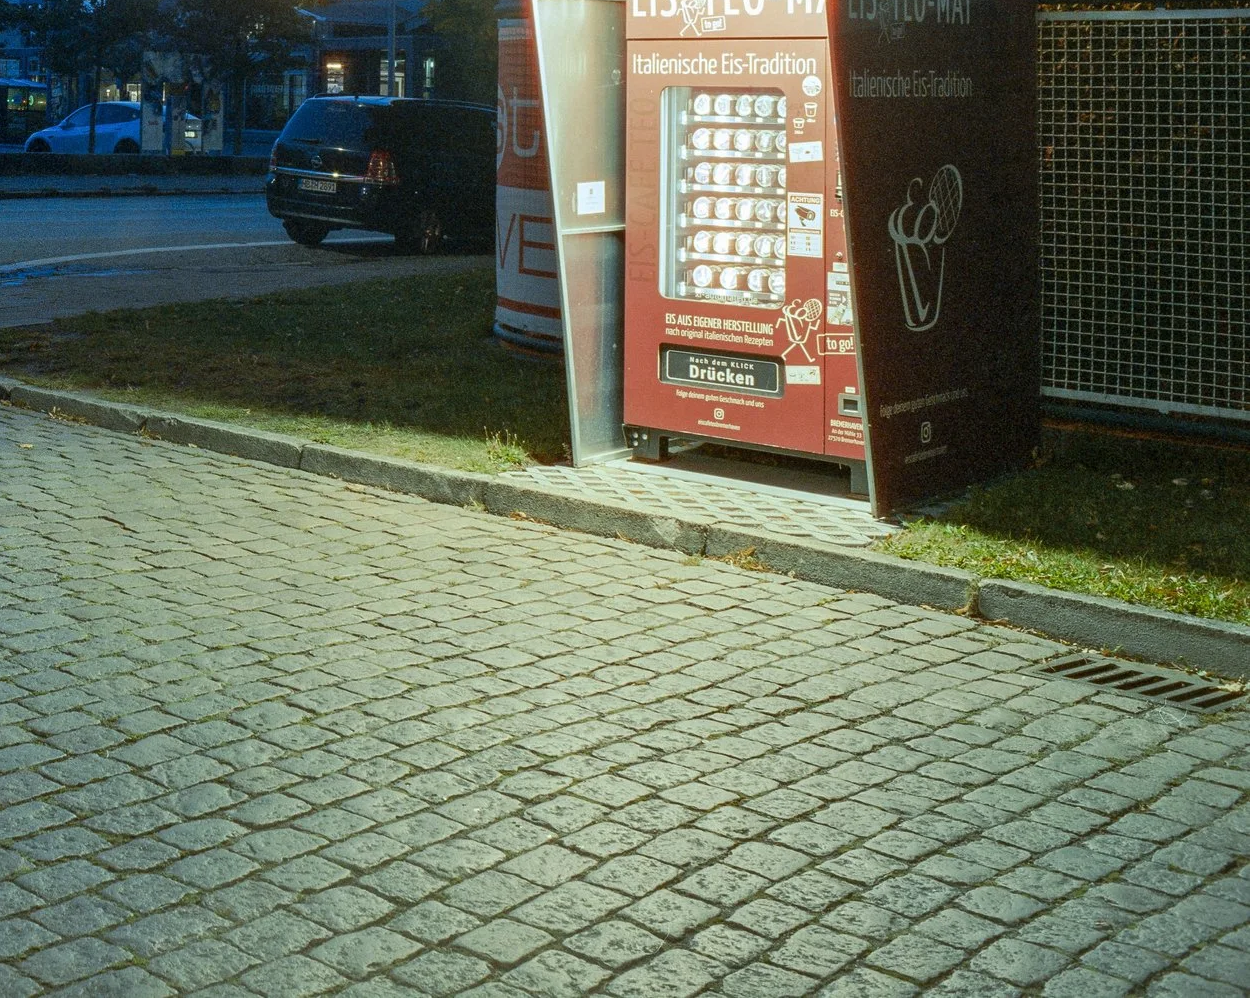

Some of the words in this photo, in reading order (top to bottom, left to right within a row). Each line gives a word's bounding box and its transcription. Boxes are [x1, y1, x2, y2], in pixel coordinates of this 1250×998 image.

[633, 53, 717, 75] Italienische
[721, 52, 817, 75] Eis-Tradition
[849, 69, 911, 98] Italienische
[913, 69, 973, 98] Eis-Tradition
[790, 196, 821, 204] ACHTUNG
[665, 313, 676, 324] EIS
[677, 315, 692, 326] AUS
[693, 316, 722, 329] EIGENER
[723, 318, 774, 335] HERSTELLUNG
[665, 327, 680, 336] nach
[680, 329, 703, 340] original
[704, 330, 743, 343] italienischen
[744, 335, 774, 347] Rezepten
[826, 337, 837, 350] to
[838, 336, 854, 353] go!
[689, 356, 709, 365] Nach
[711, 359, 728, 367] dem
[730, 362, 754, 370] KLICK
[689, 364, 755, 386] Drücken
